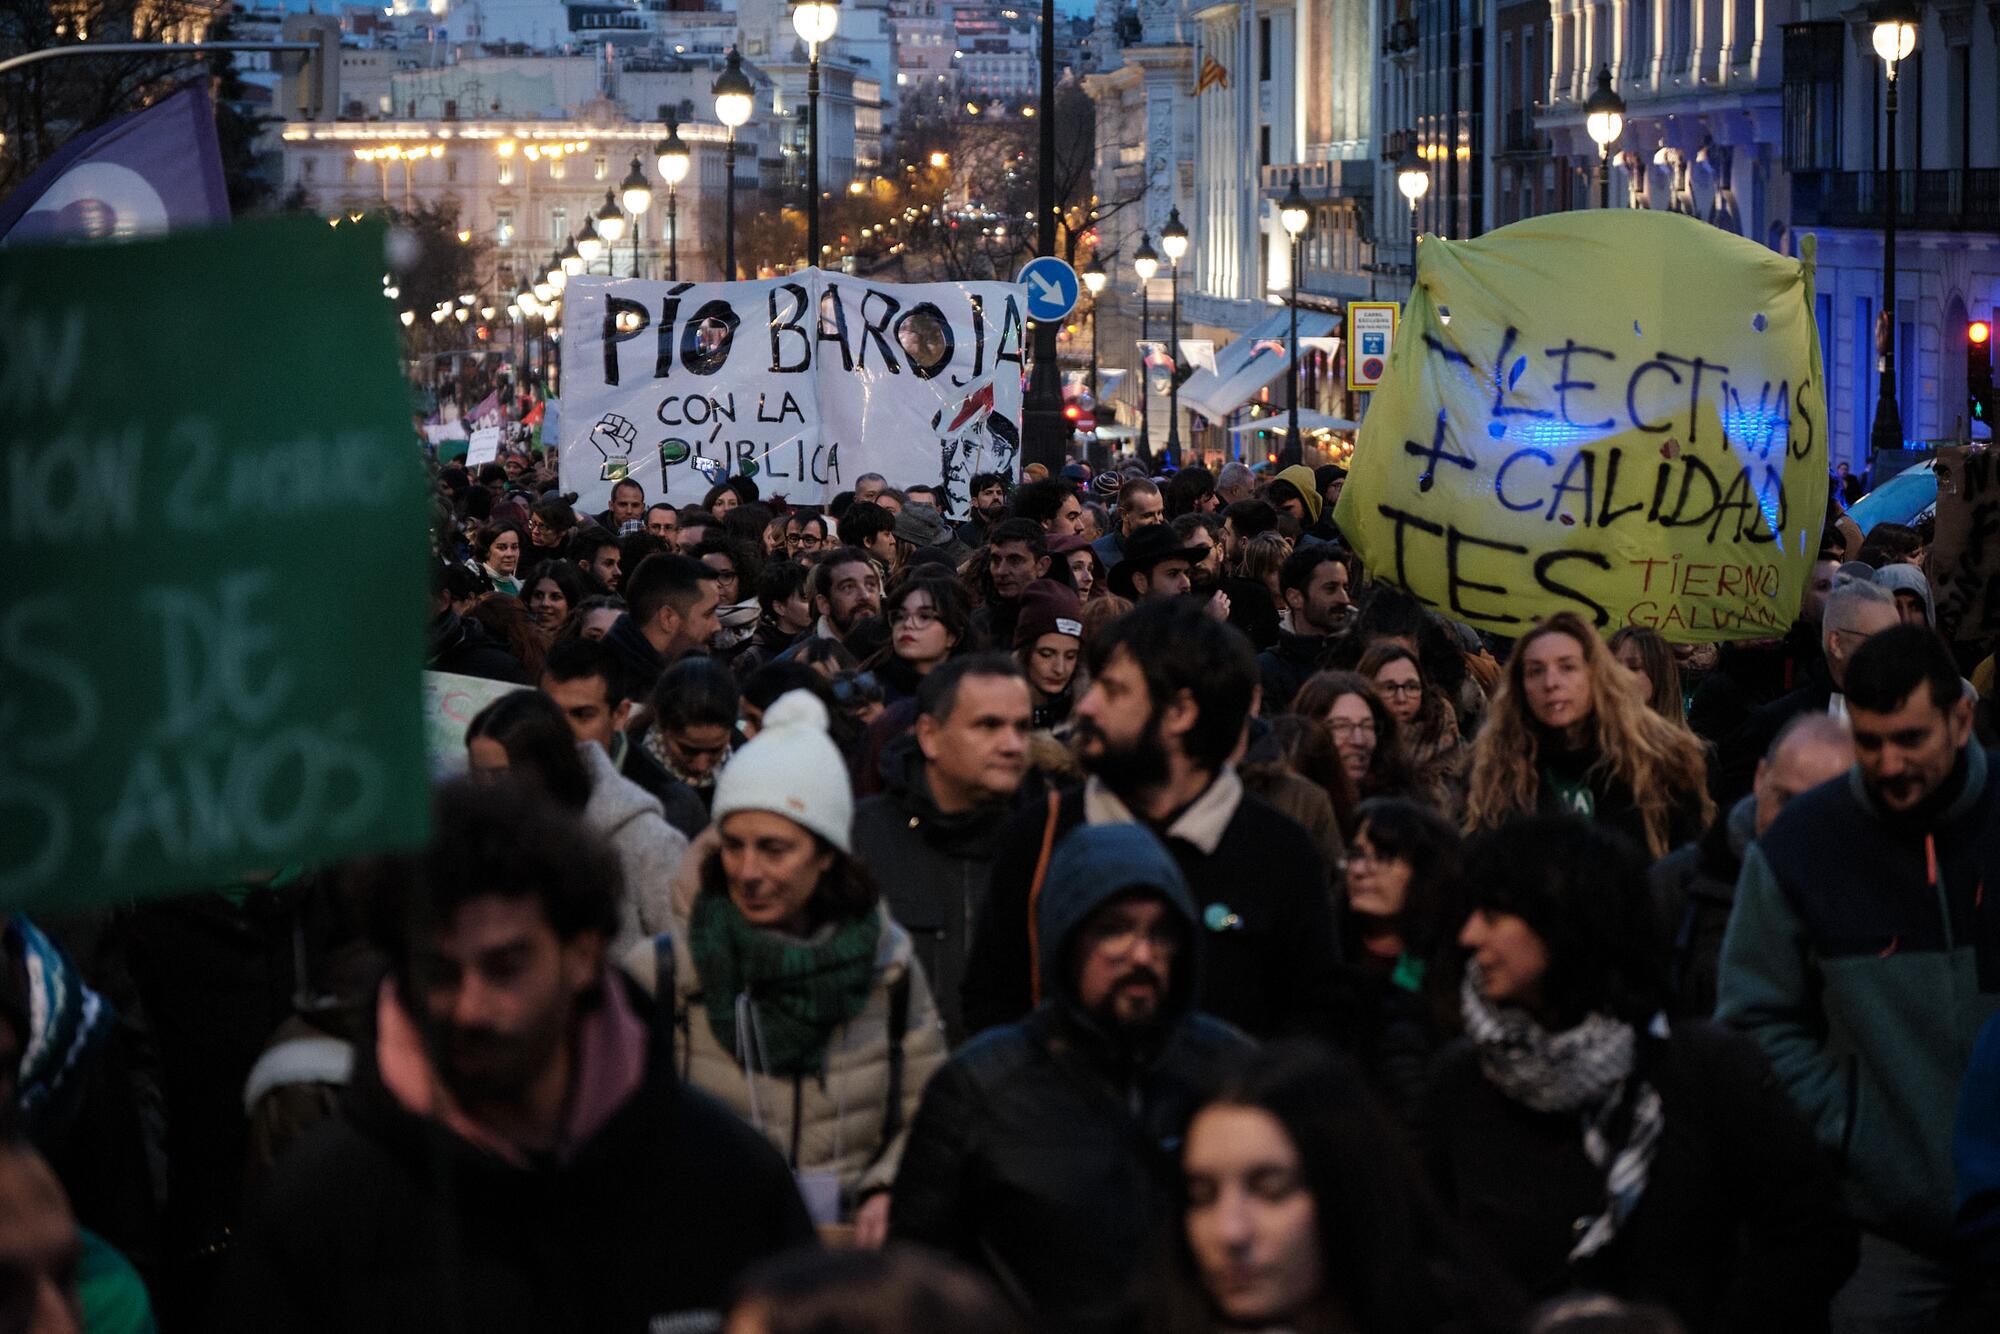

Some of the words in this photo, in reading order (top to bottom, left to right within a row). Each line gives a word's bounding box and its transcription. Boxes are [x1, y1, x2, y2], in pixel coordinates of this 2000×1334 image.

[602, 282, 741, 387] PÍO
[768, 282, 1025, 389] BAROJA
[657, 392, 736, 426] CON
[757, 390, 806, 424] LA
[1494, 446, 1788, 544] CALIDAD
